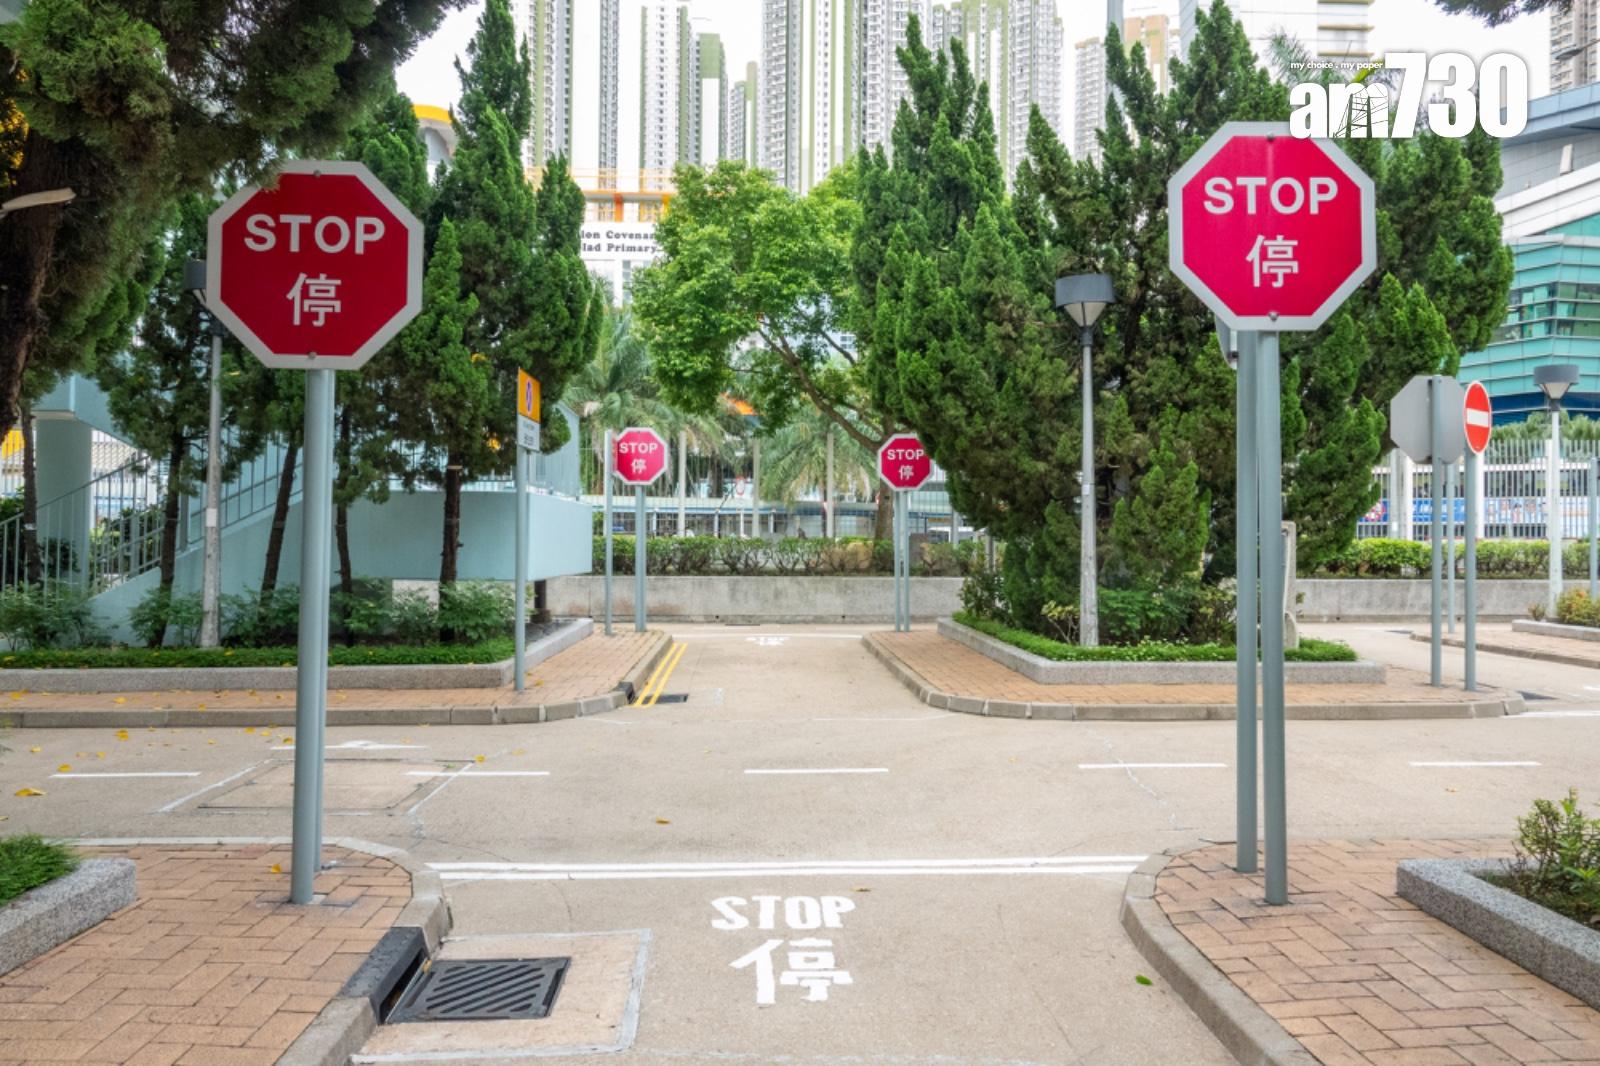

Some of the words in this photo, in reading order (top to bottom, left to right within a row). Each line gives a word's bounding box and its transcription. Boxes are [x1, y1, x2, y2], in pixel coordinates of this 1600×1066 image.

[1203, 176, 1338, 215] STOP
[244, 213, 385, 255] STOP
[583, 243, 601, 252] lad
[607, 243, 657, 254] Primary
[1245, 234, 1299, 288] 停
[286, 272, 342, 327] 停
[619, 442, 658, 454] STOP
[887, 448, 924, 460] STOP
[711, 895, 856, 930] STOP
[728, 937, 853, 1004] 停
